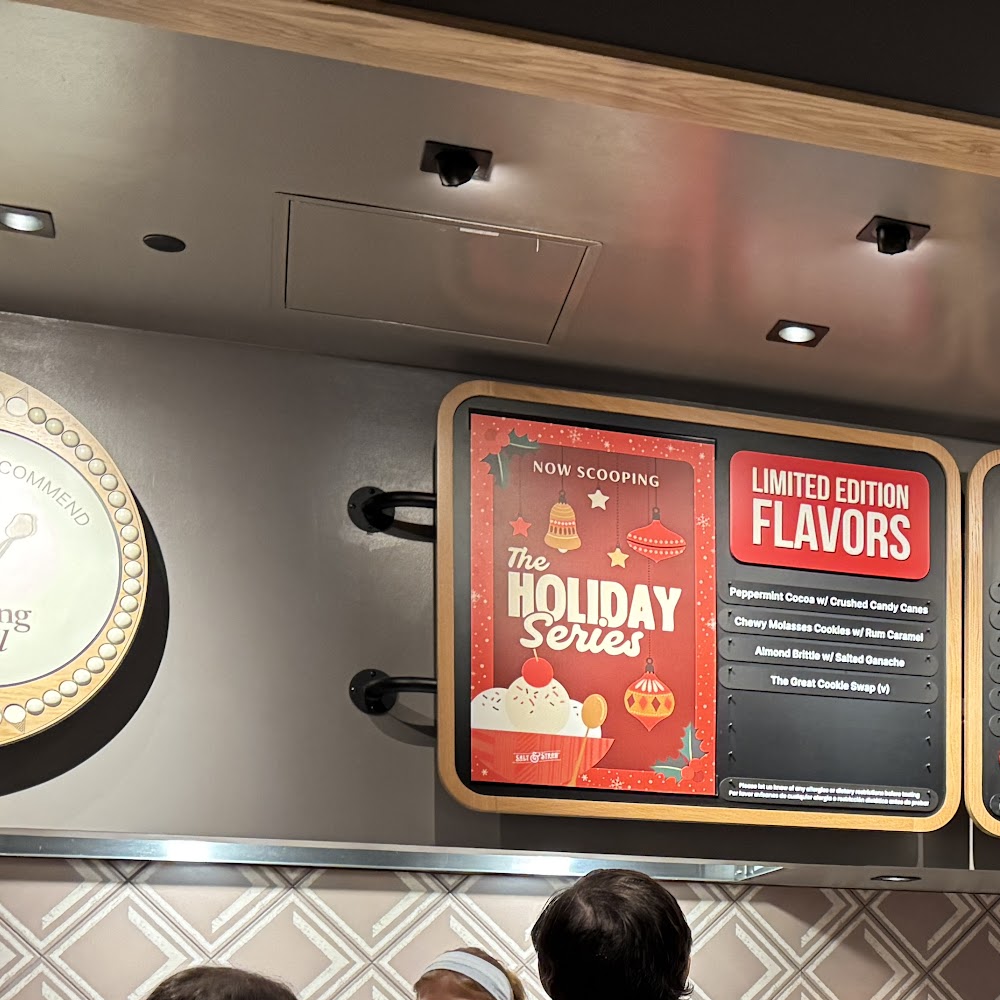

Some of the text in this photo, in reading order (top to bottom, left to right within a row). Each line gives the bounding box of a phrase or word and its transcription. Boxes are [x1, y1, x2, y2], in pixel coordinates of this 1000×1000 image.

[534, 461, 660, 488] NOW SCOOPING
[752, 467, 909, 509] LIMITED EDITION
[753, 498, 911, 561] FLAVORS
[508, 547, 550, 571] The
[508, 572, 682, 632] HOLIDAY
[729, 587, 928, 614] Peppermint Cocoa w/ Crushed Candy Canes
[519, 612, 644, 657] Series
[734, 617, 923, 642] Chewy Molasses Cookies w/ Rum Caramel
[755, 646, 905, 667] Almond Brittle w/ Salted Ganache
[770, 675, 890, 695] The Great Cookie Swap (v)
